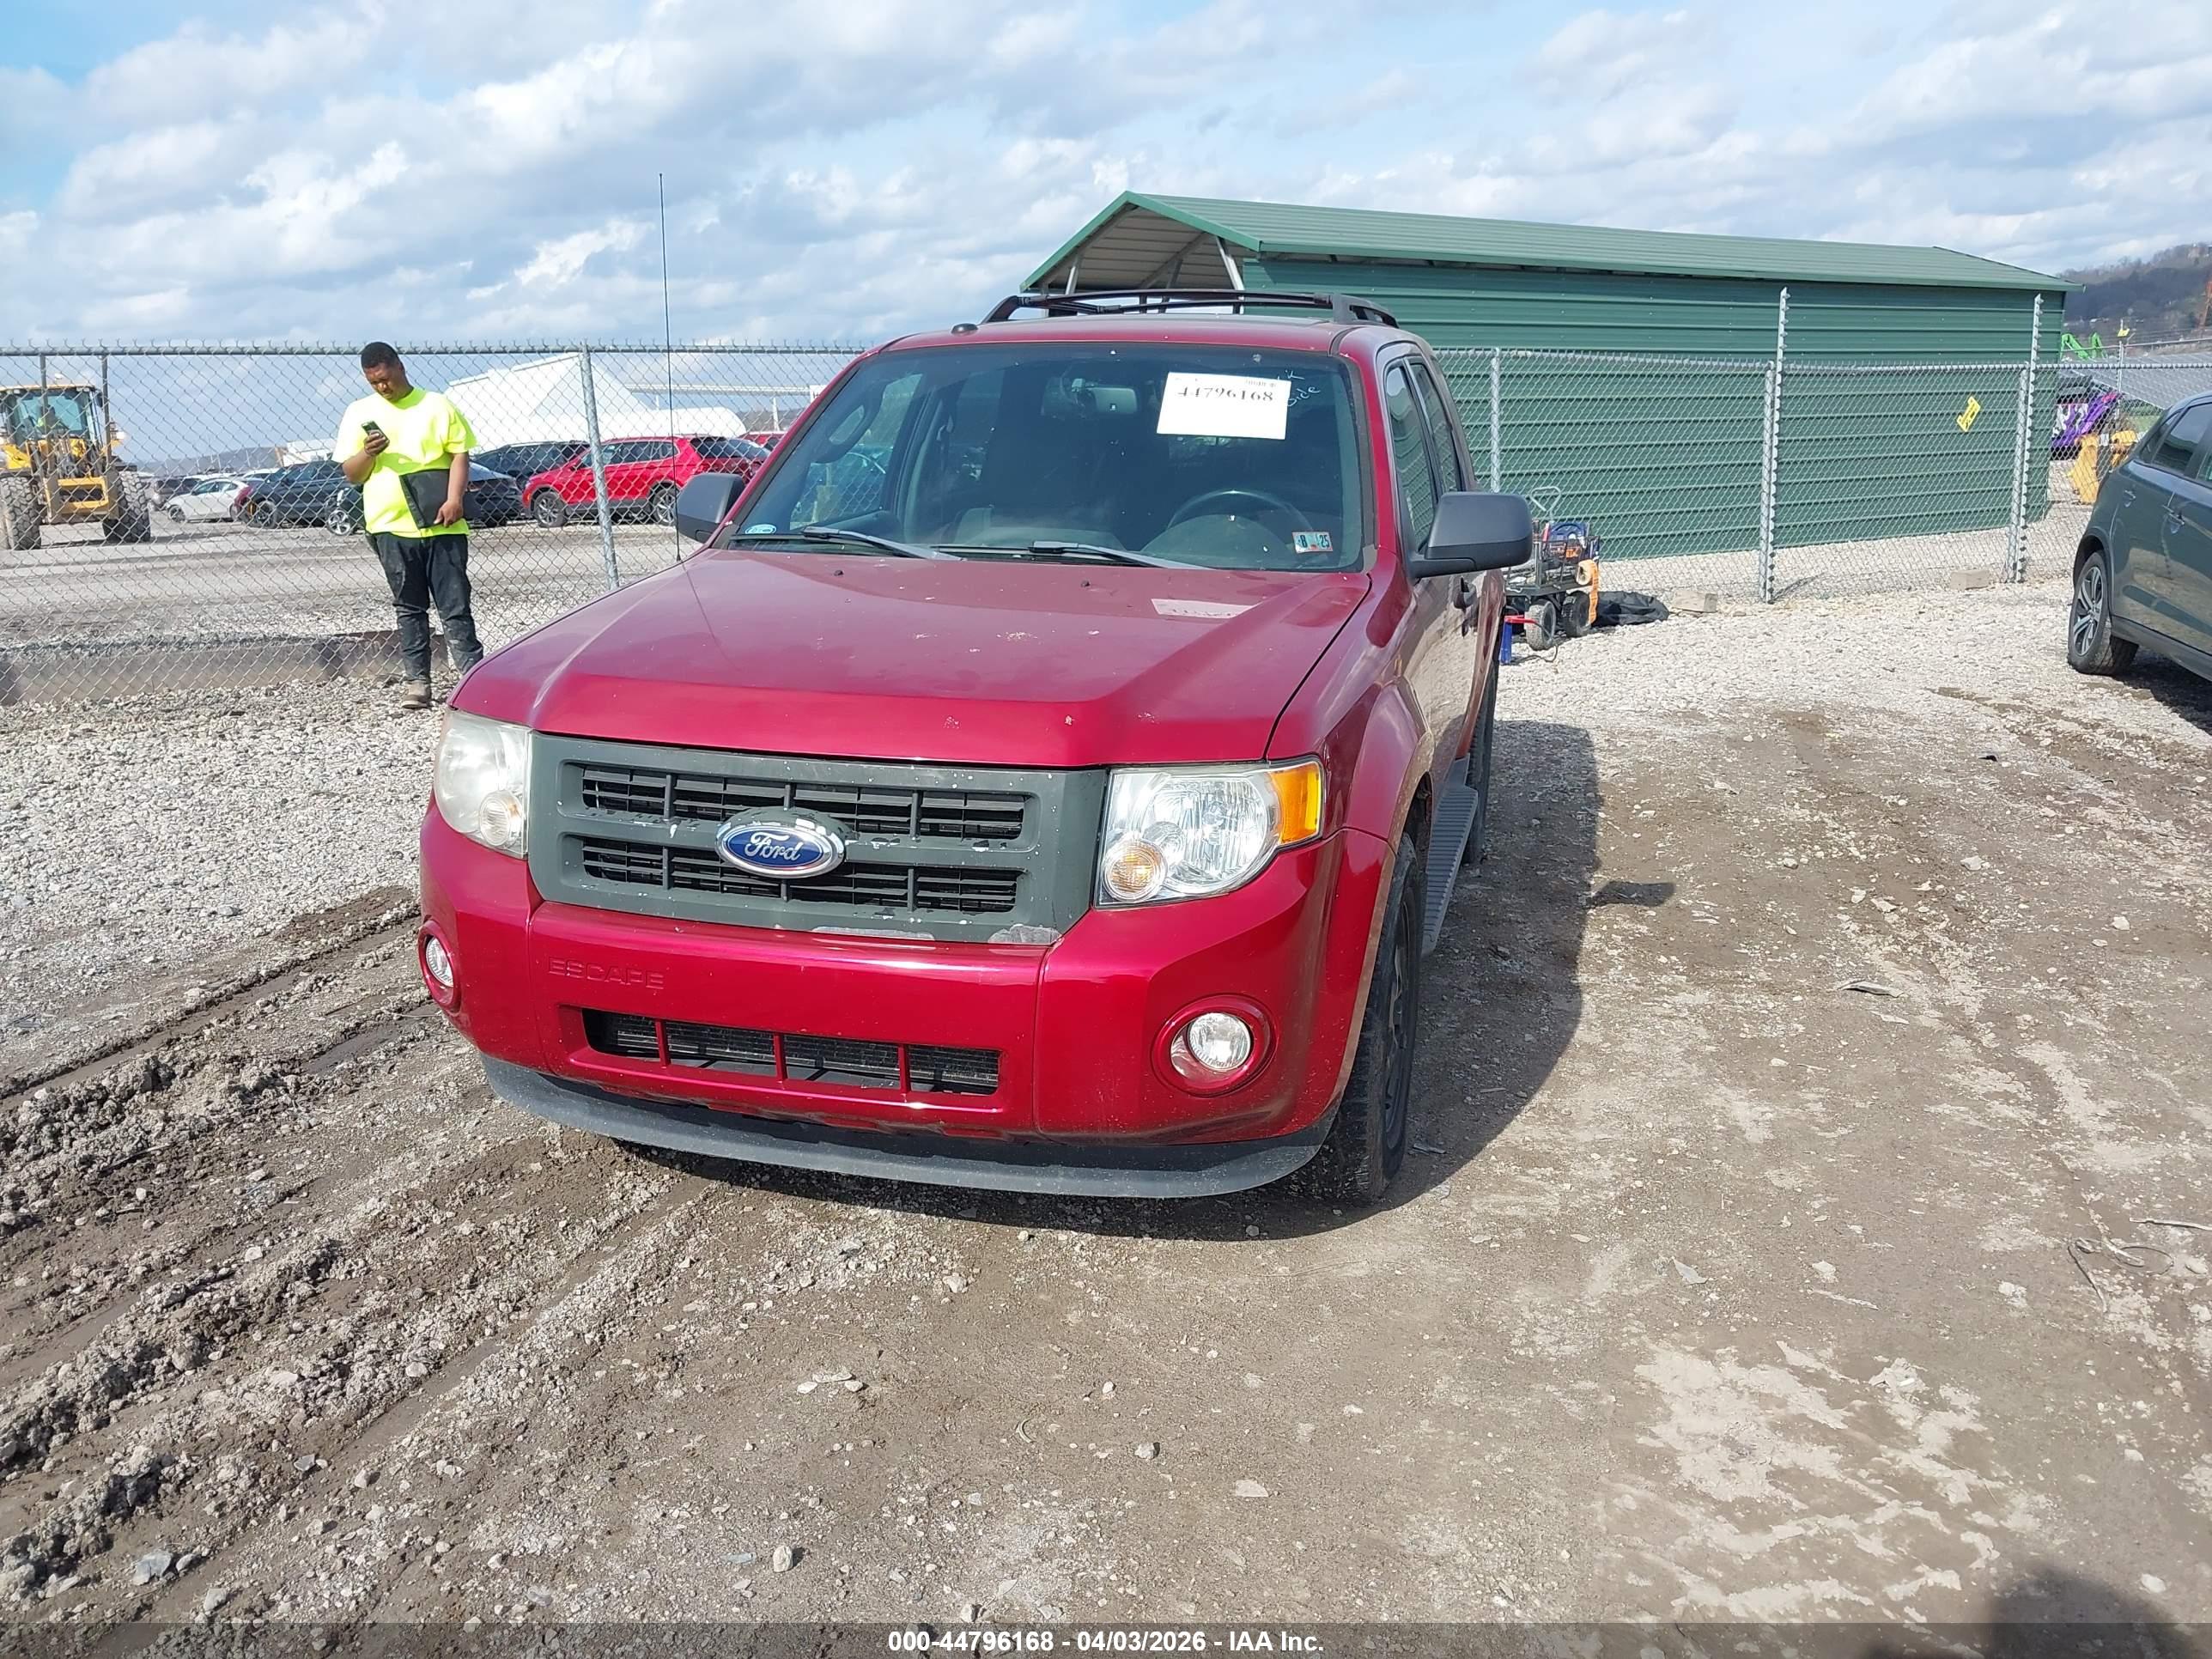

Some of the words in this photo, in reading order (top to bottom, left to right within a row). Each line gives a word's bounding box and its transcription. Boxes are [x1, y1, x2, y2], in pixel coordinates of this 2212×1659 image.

[1319, 534, 1330, 548] 25
[744, 831, 805, 861] Ford
[548, 957, 665, 990] ESCAPE
